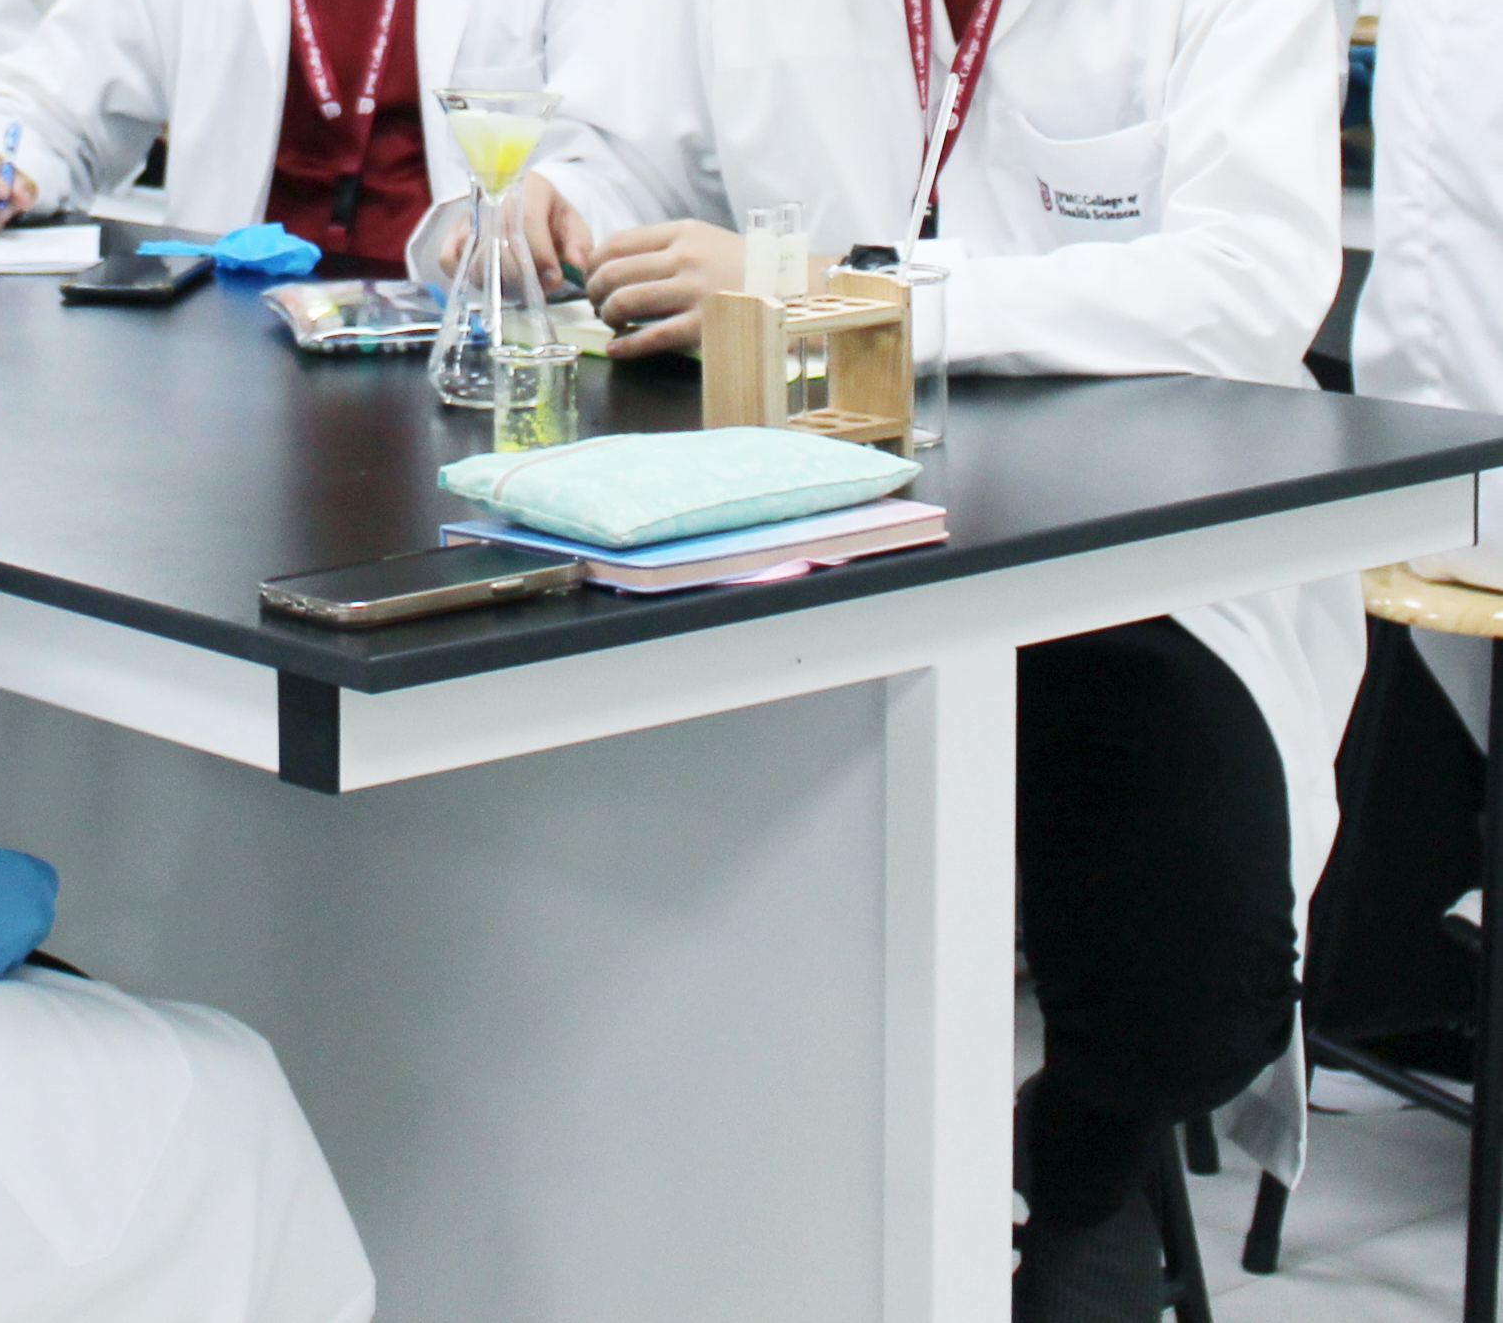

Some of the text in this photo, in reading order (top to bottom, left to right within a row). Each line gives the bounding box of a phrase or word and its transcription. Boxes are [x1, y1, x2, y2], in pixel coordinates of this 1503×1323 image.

[1083, 194, 1123, 209] College
[1127, 193, 1138, 204] of
[1058, 204, 1141, 219] Health Sciences
